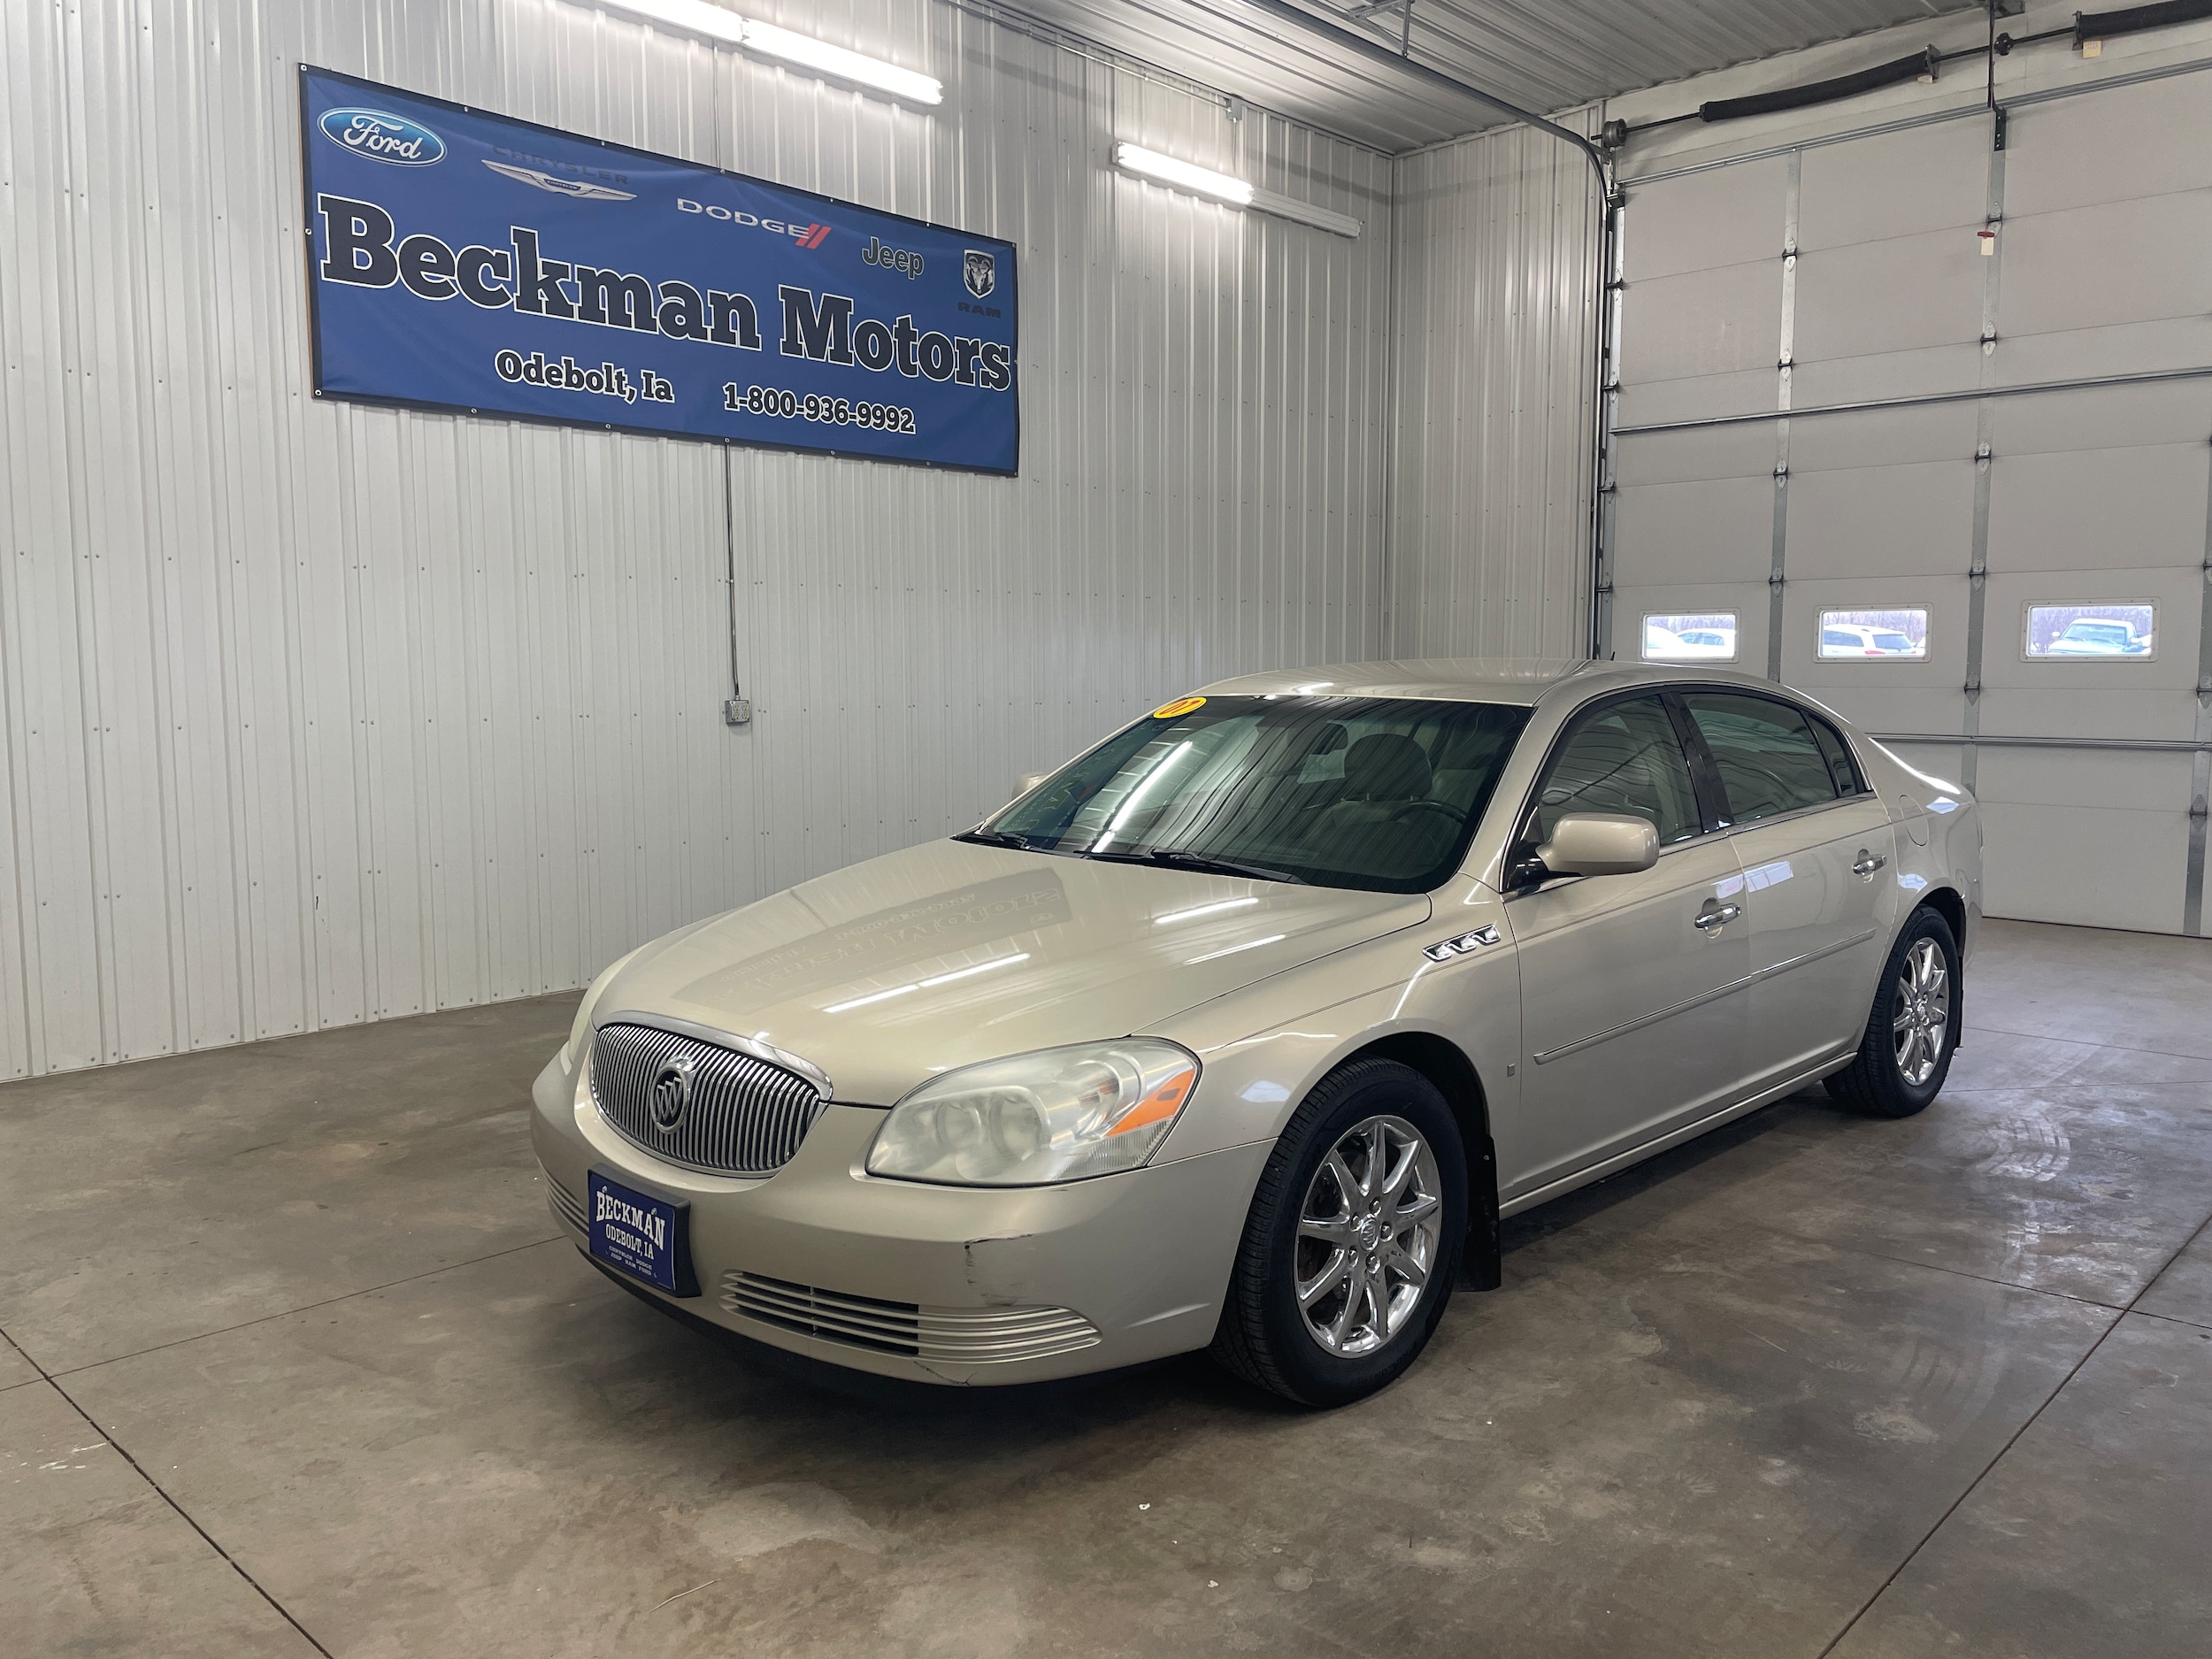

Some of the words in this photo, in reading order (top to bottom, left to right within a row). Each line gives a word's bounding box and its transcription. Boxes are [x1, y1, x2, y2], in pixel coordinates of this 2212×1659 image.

[343, 115, 422, 159] Ford
[493, 145, 629, 184] CHRYSLER
[677, 198, 810, 238] DODGE
[862, 236, 925, 280] Jeep
[318, 192, 762, 351] Beckman
[779, 284, 1010, 391] Motors
[958, 302, 1002, 319] RAM
[495, 349, 637, 404] Odebolt,
[641, 369, 675, 403] Ia
[723, 382, 916, 434] 1-800-936-9992
[596, 1191, 665, 1251] BECKMAN
[605, 1223, 642, 1256] ODEBOLT,
[643, 1241, 655, 1260] IA
